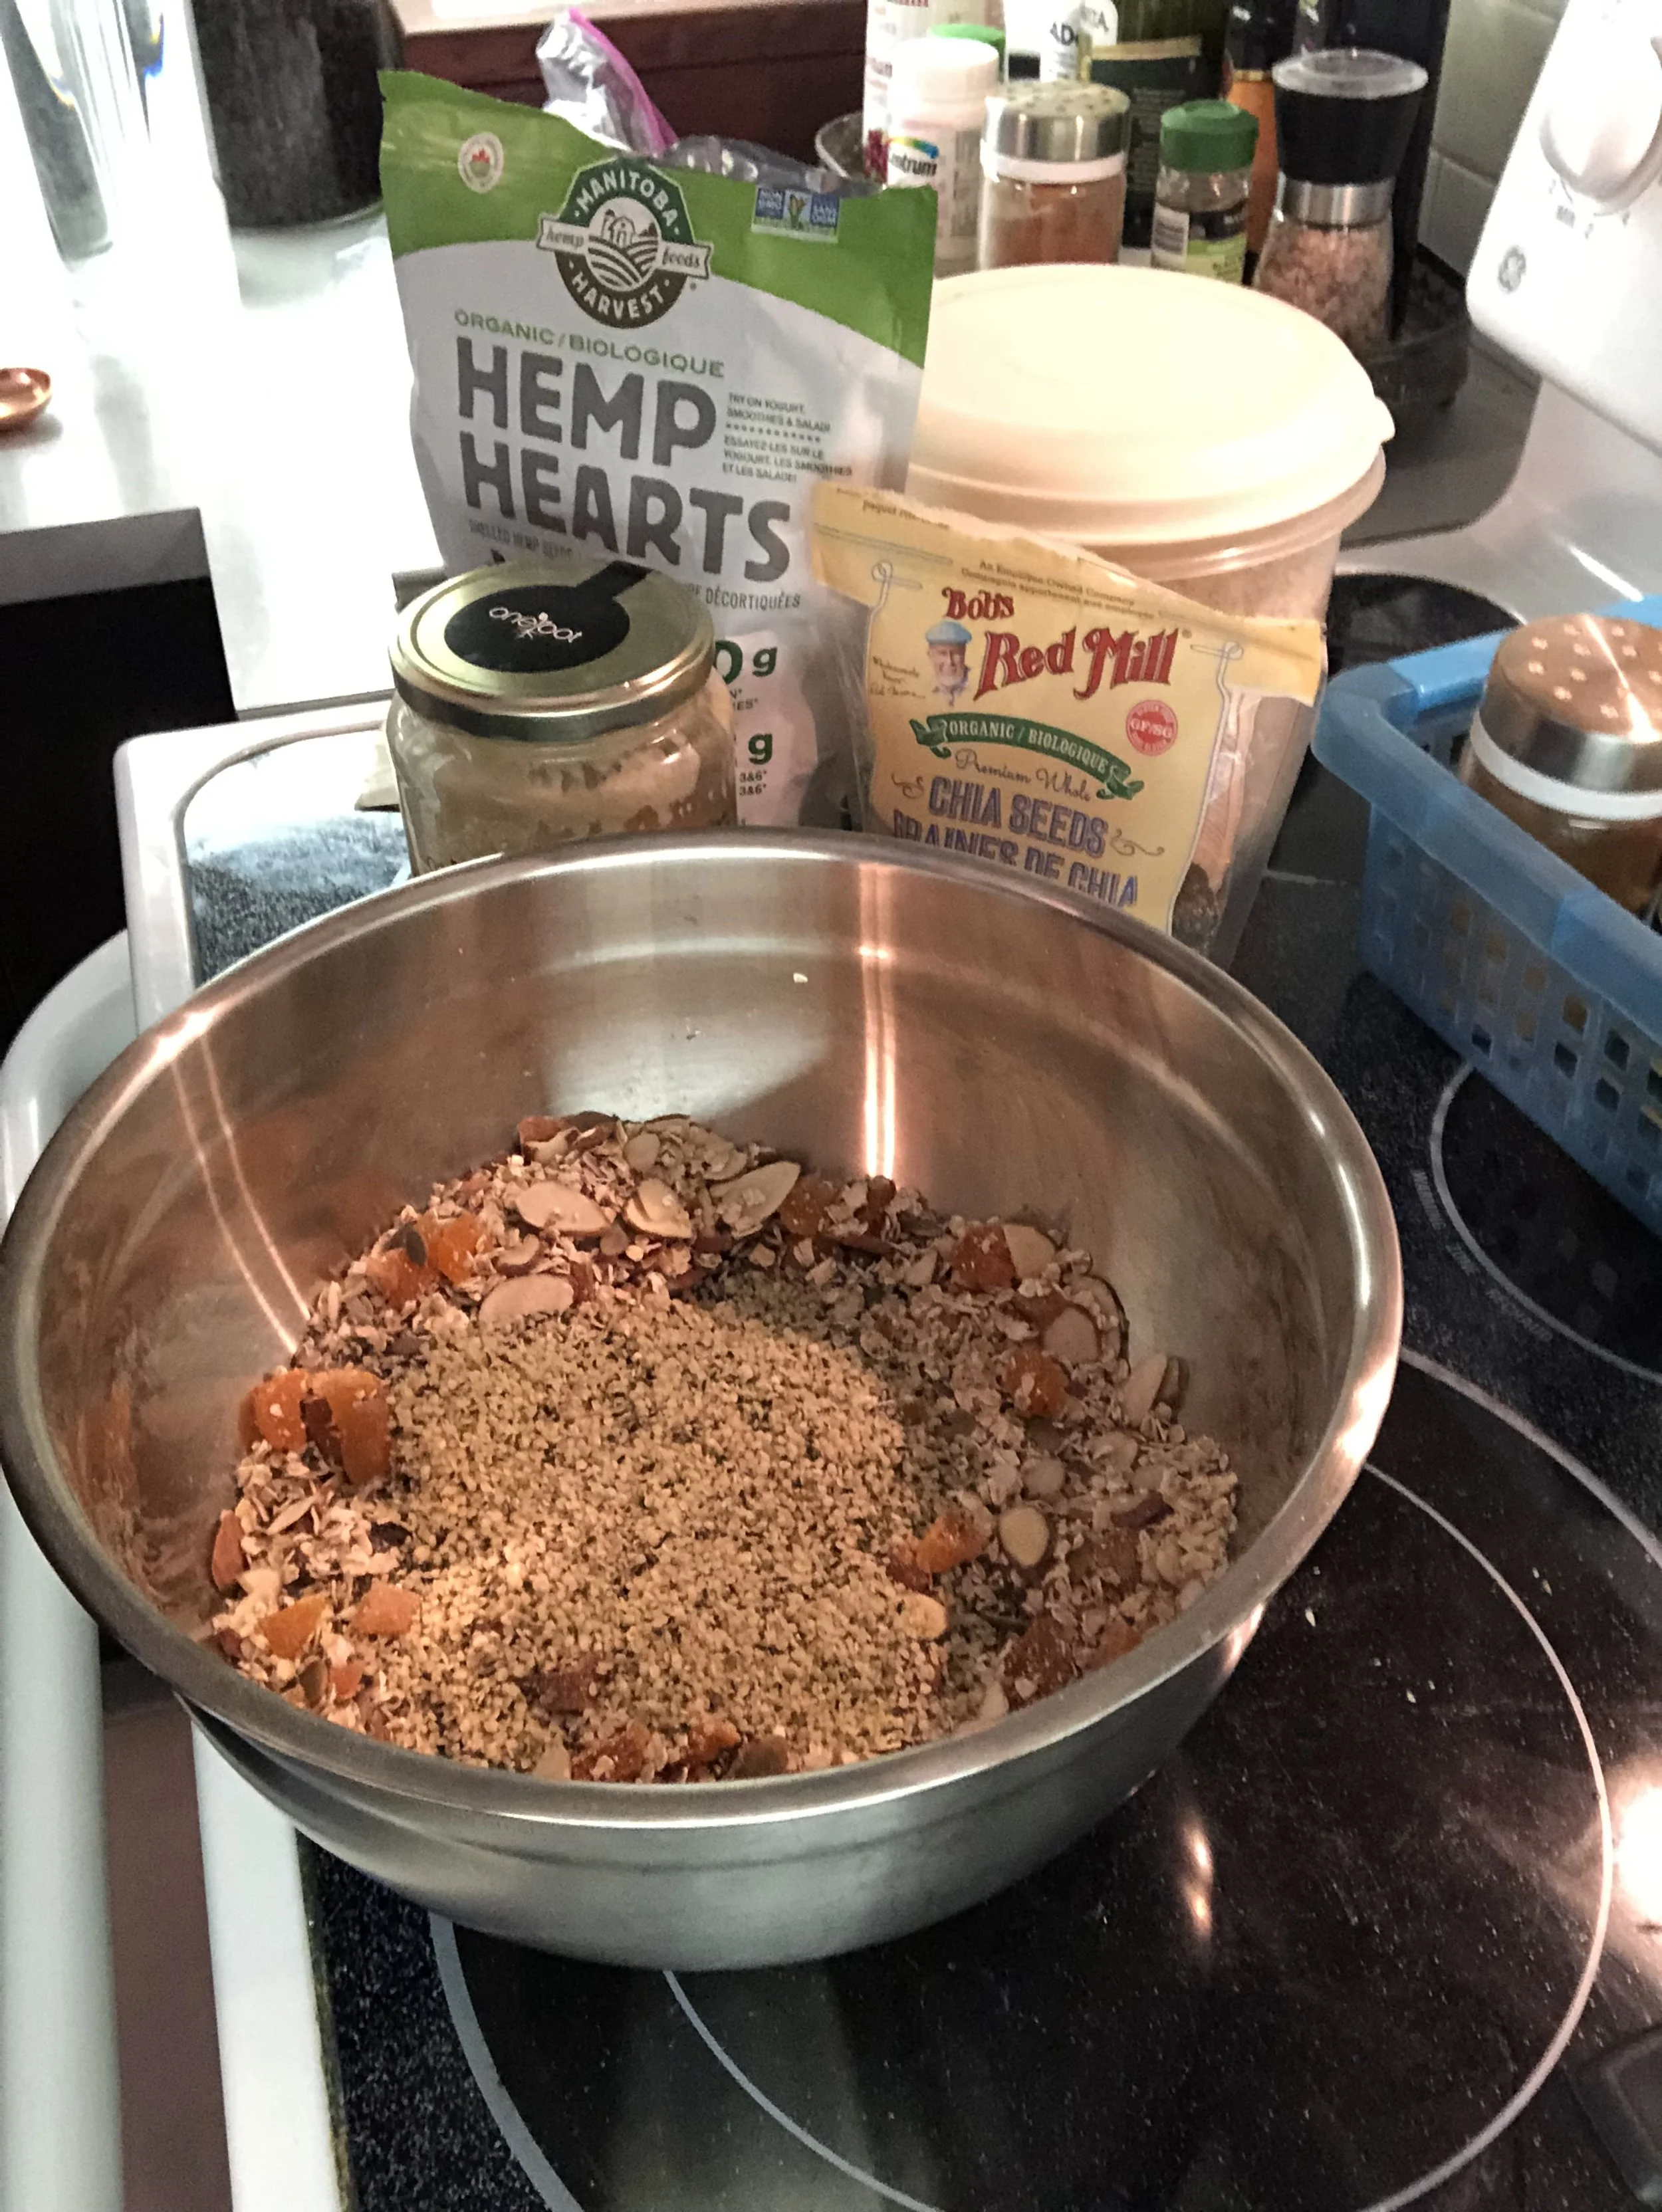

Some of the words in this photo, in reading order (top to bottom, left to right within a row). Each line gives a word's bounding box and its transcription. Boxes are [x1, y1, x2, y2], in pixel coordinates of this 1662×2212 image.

[575, 168, 679, 227] MANITOBA
[546, 225, 585, 251] hemp
[662, 245, 700, 269] foods
[571, 271, 664, 320] HARVEST
[457, 336, 717, 466] HEMP
[459, 430, 791, 582] HEARTS
[706, 585, 801, 611] DÉCORTIQUÉES
[752, 646, 778, 677] g
[973, 625, 1077, 702] Red
[1072, 627, 1179, 701] Mill
[747, 732, 773, 765] g
[949, 719, 1014, 740] ORGANIC
[1028, 728, 1110, 775] BIOLOGIQUE
[954, 748, 1031, 784] Premium
[1035, 767, 1092, 802] Whole
[928, 775, 1003, 830] CHIA
[1008, 794, 1110, 859] SEEDS
[1068, 861, 1139, 908] CHIA
